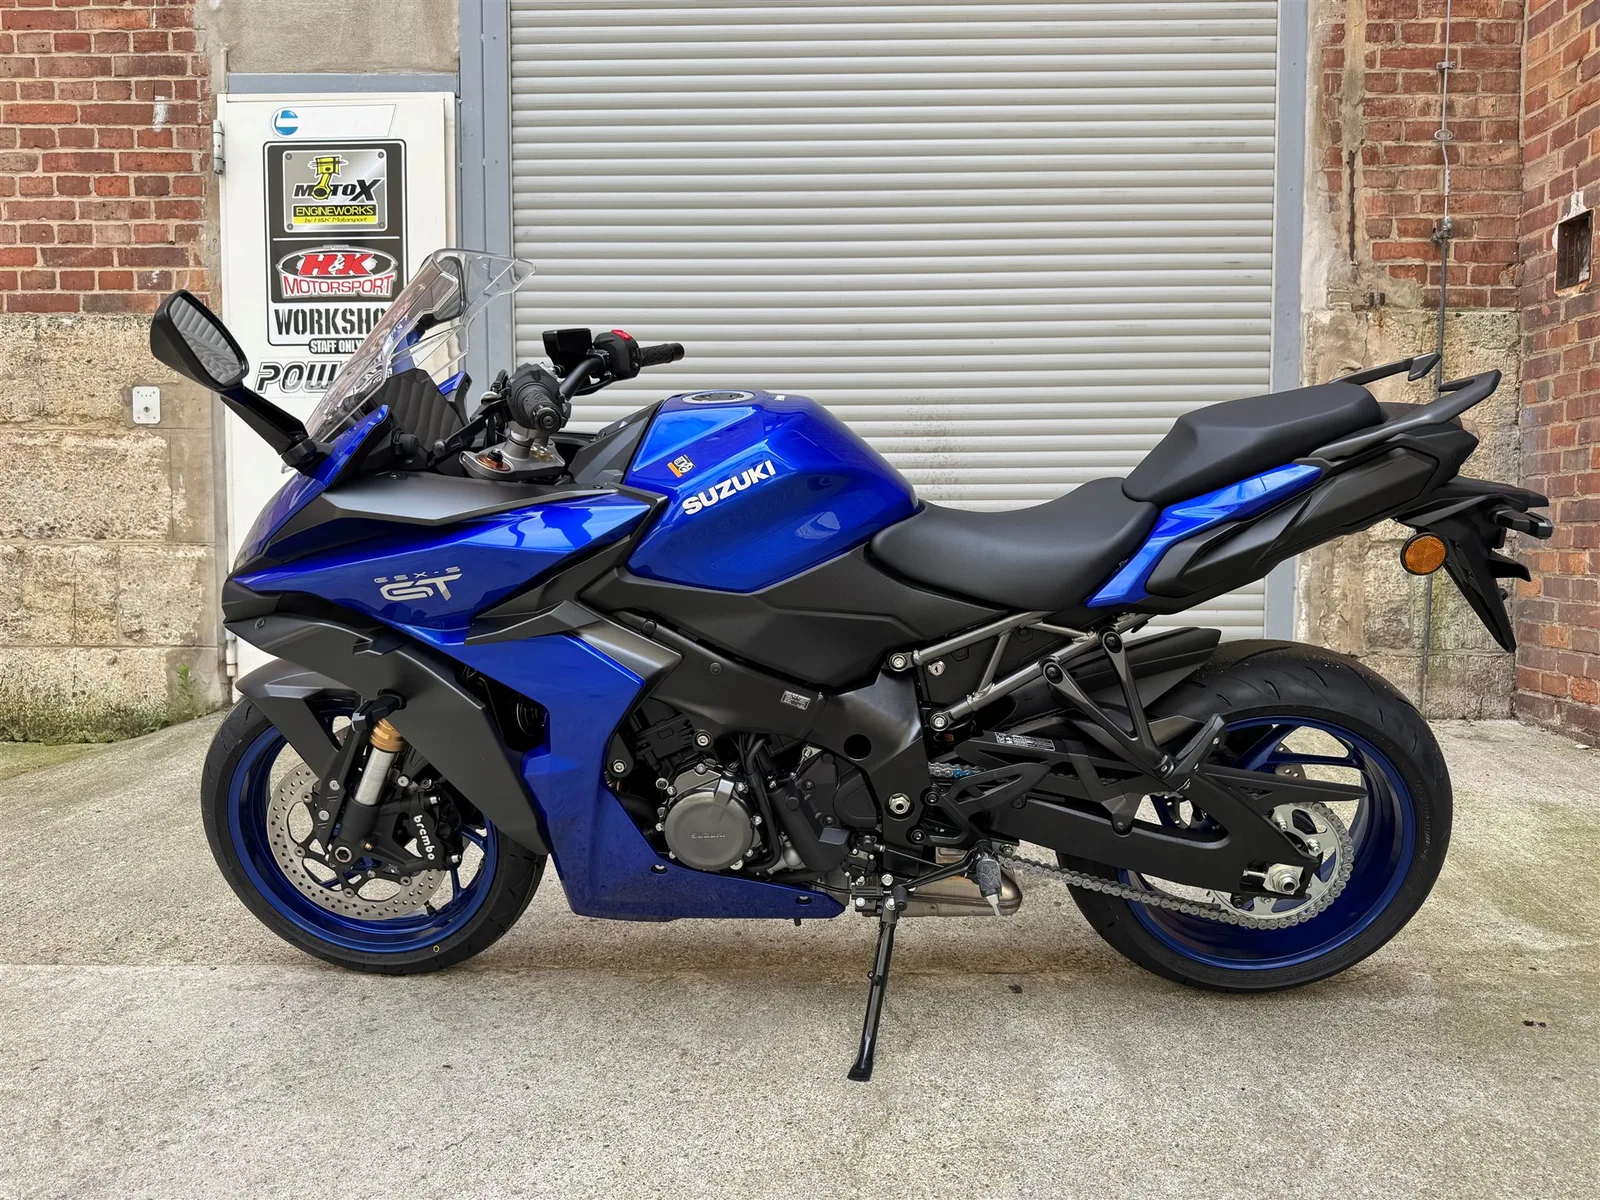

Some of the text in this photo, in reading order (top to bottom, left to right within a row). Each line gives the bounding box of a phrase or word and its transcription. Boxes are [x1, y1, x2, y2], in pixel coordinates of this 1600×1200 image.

[296, 206, 374, 216] ENGINEWORKS
[300, 253, 374, 276] H&K
[282, 275, 395, 295] MOTORSPORT
[274, 308, 388, 335] WORKSHO
[310, 340, 337, 353] STAFF
[682, 460, 776, 515] SUZUKI
[380, 573, 463, 601] GT
[413, 814, 436, 860] brembo
